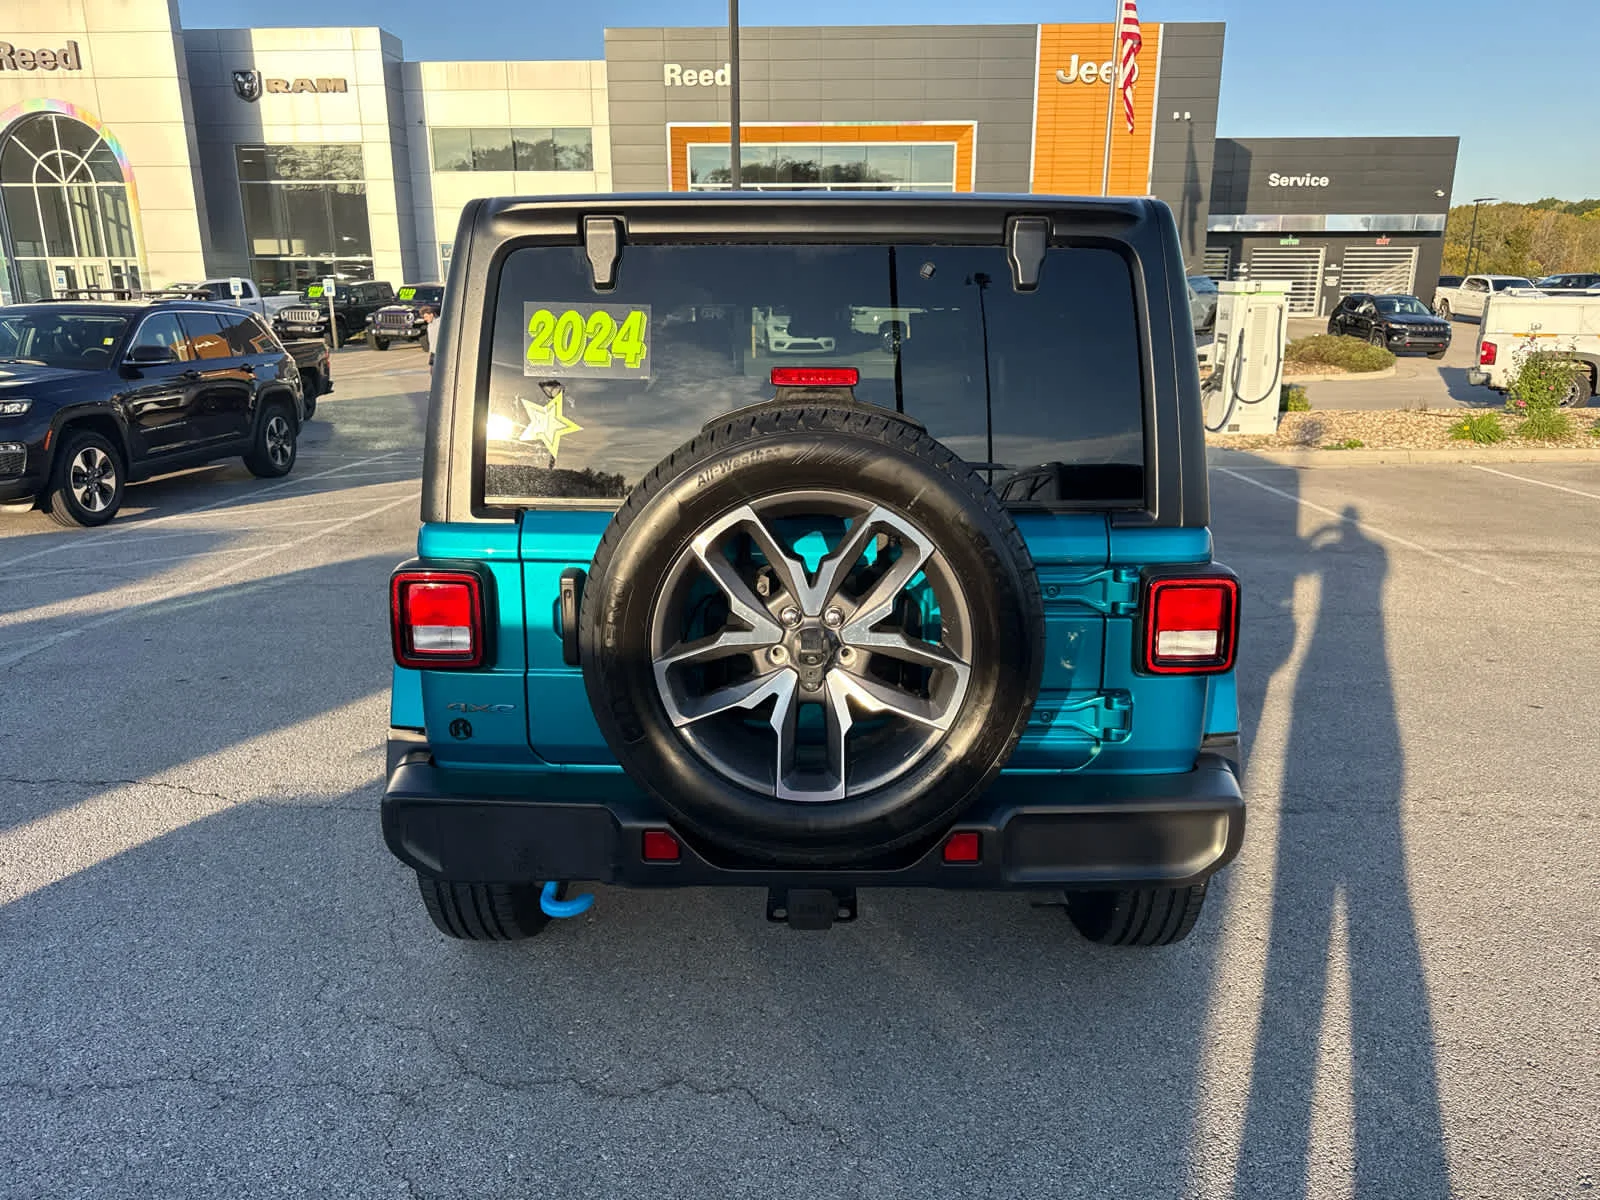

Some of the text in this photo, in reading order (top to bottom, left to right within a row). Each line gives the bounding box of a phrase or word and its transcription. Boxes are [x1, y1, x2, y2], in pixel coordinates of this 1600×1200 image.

[0, 40, 82, 71] Reed
[265, 79, 348, 93] RAM
[663, 63, 731, 87] Reed
[1268, 173, 1329, 187] Service
[526, 309, 648, 368] 2024
